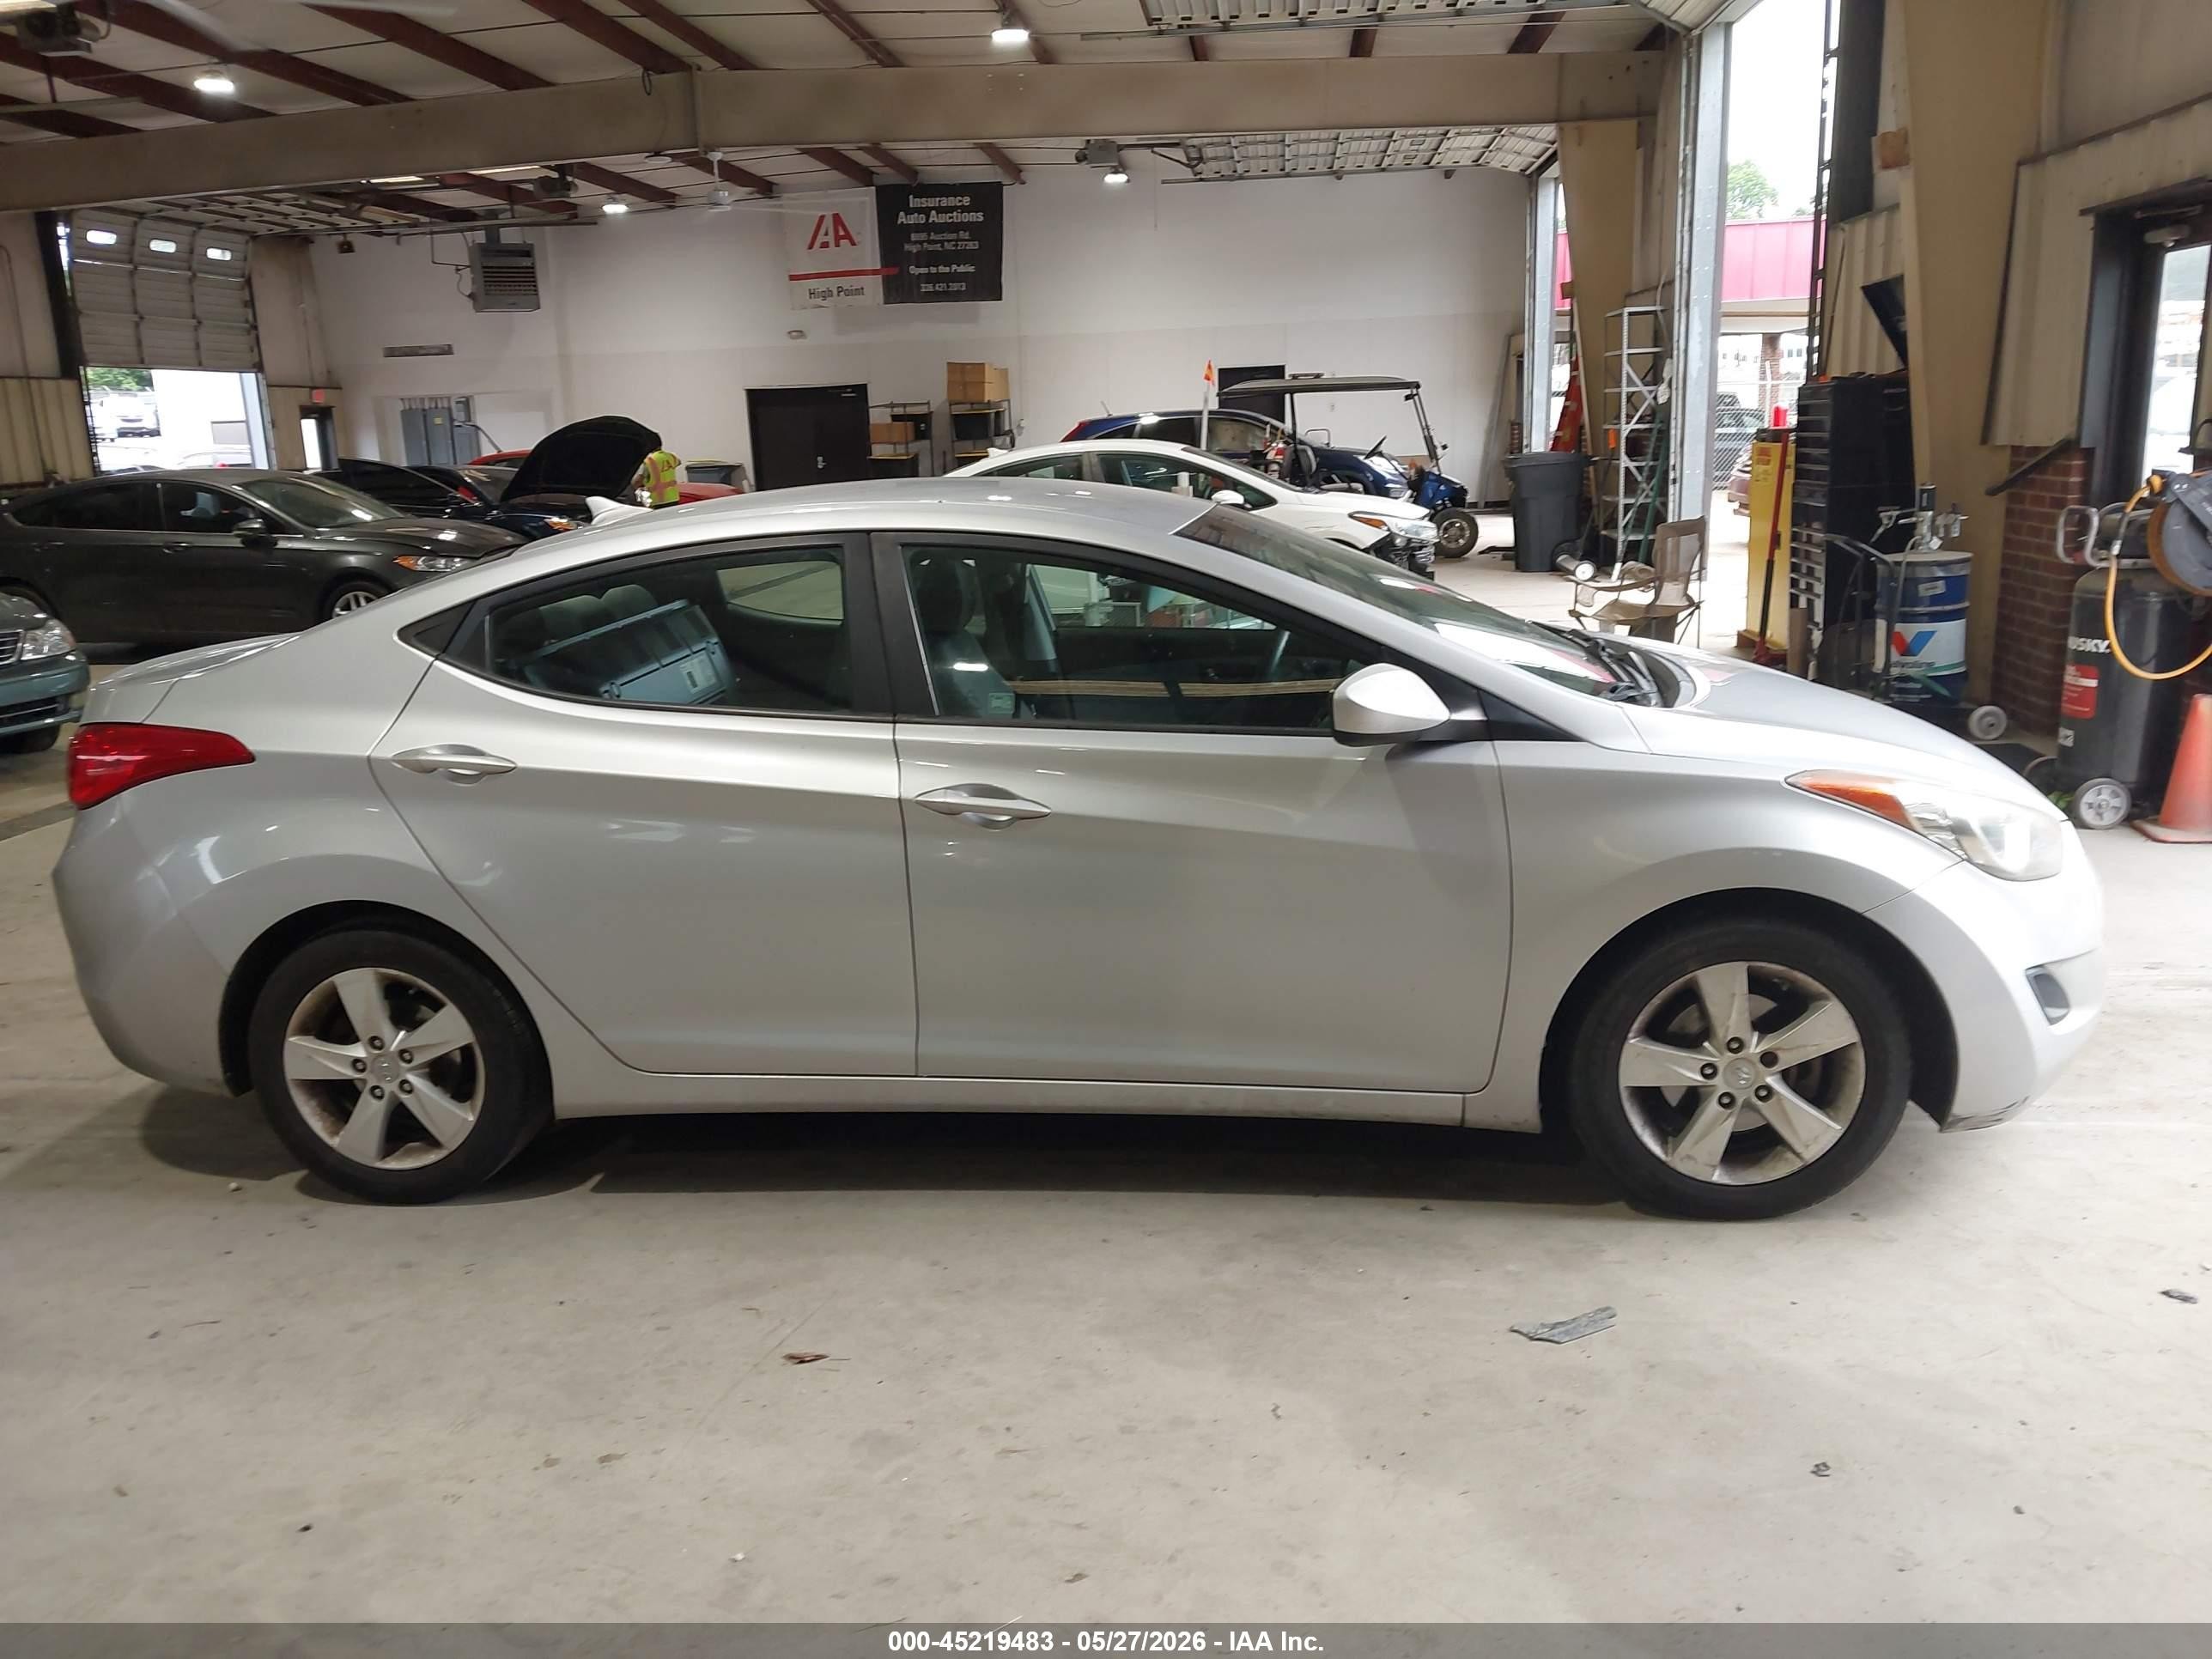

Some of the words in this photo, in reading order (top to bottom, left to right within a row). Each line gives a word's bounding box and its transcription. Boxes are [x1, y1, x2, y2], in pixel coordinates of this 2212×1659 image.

[908, 194, 970, 208] Insurance
[897, 210, 927, 224] Auto
[928, 209, 984, 223] Auctions
[808, 287, 834, 301] High
[836, 284, 866, 297] Point
